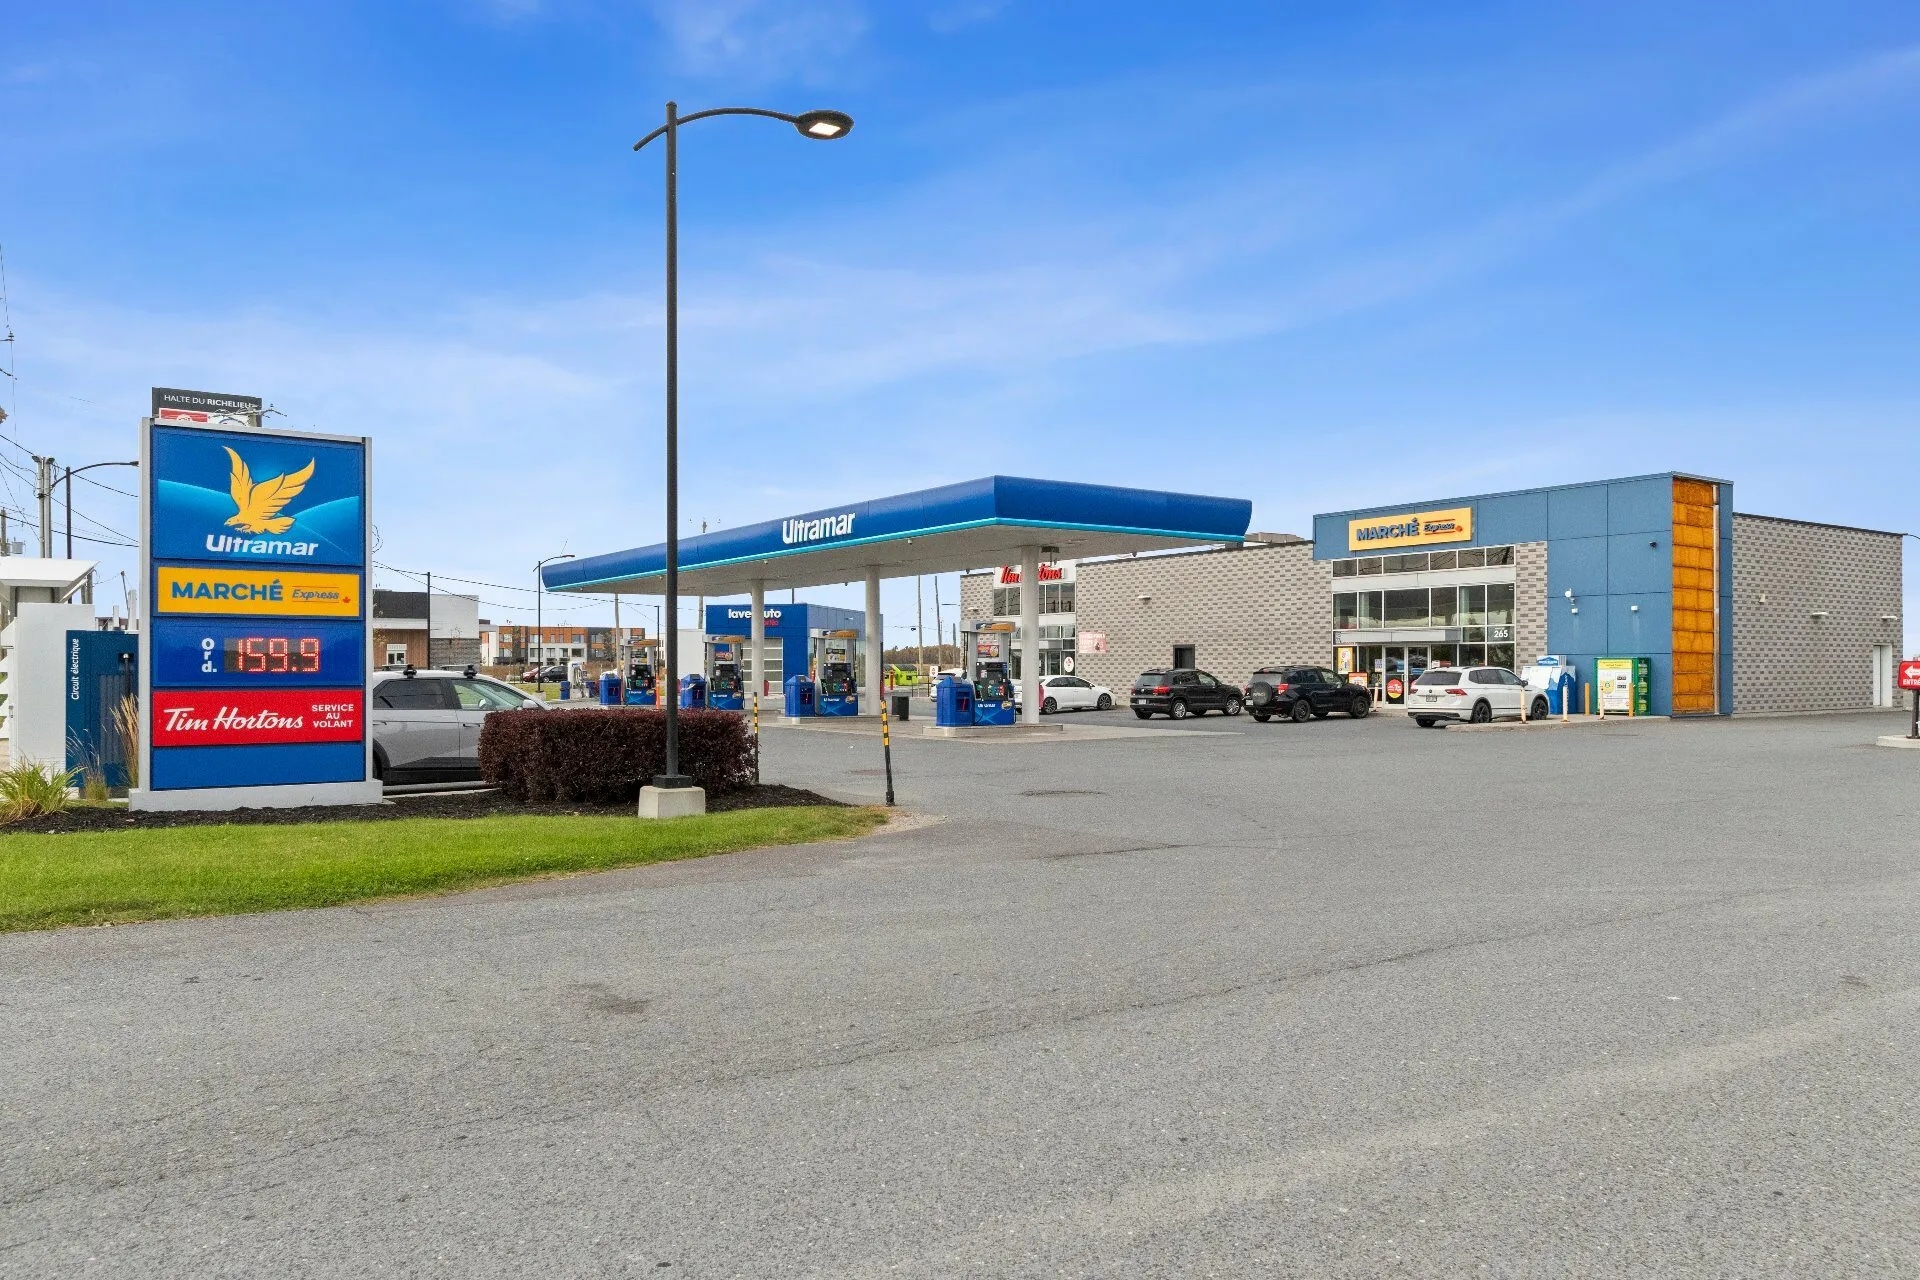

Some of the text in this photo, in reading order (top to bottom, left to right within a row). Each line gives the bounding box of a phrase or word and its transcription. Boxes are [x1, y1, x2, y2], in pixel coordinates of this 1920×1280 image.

[164, 394, 252, 409] HALTE DU RICHELIEU
[782, 512, 856, 545] Ultramar
[1357, 517, 1420, 541] MARCHÉ
[206, 534, 318, 555] Ultramar
[171, 578, 340, 601] MARCHÉ Express
[1493, 629, 1509, 638] 265
[237, 637, 320, 673] 159.9
[70, 638, 81, 700] Circuit électrique
[164, 706, 303, 731] Tim Hortons
[311, 703, 355, 712] SERVICE
[326, 712, 340, 720] AU
[312, 720, 353, 728] VOLANT
